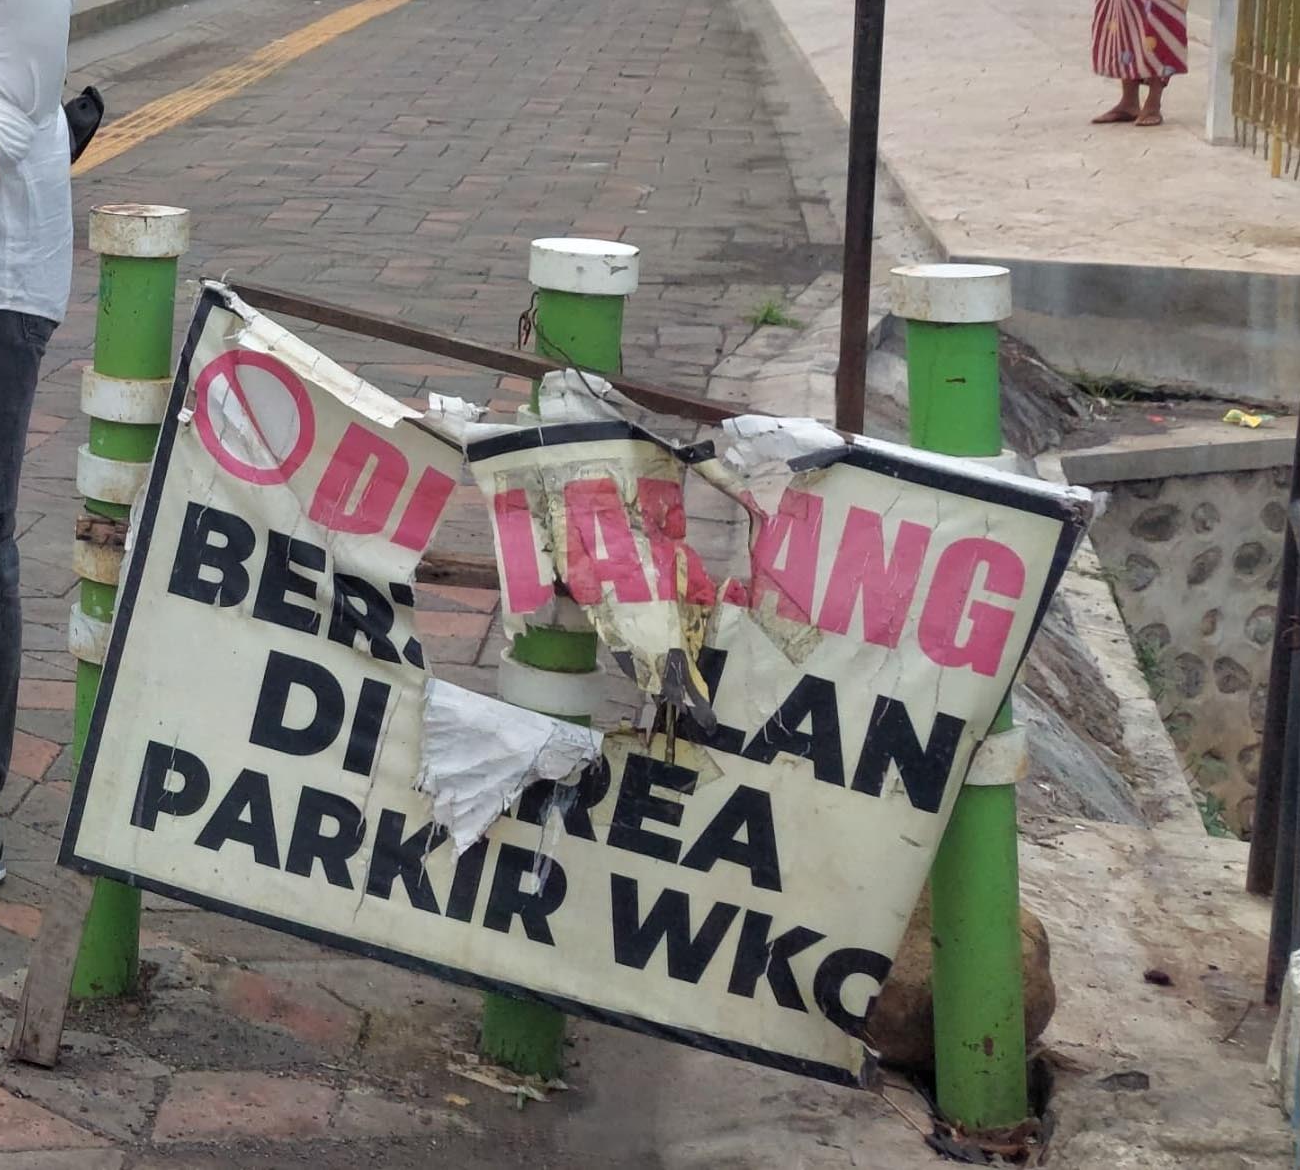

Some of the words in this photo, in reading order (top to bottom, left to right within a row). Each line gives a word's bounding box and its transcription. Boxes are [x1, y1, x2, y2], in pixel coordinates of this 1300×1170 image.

[131, 741, 568, 946] PARKIR
[249, 650, 392, 777] DI
[501, 750, 782, 891] REA
